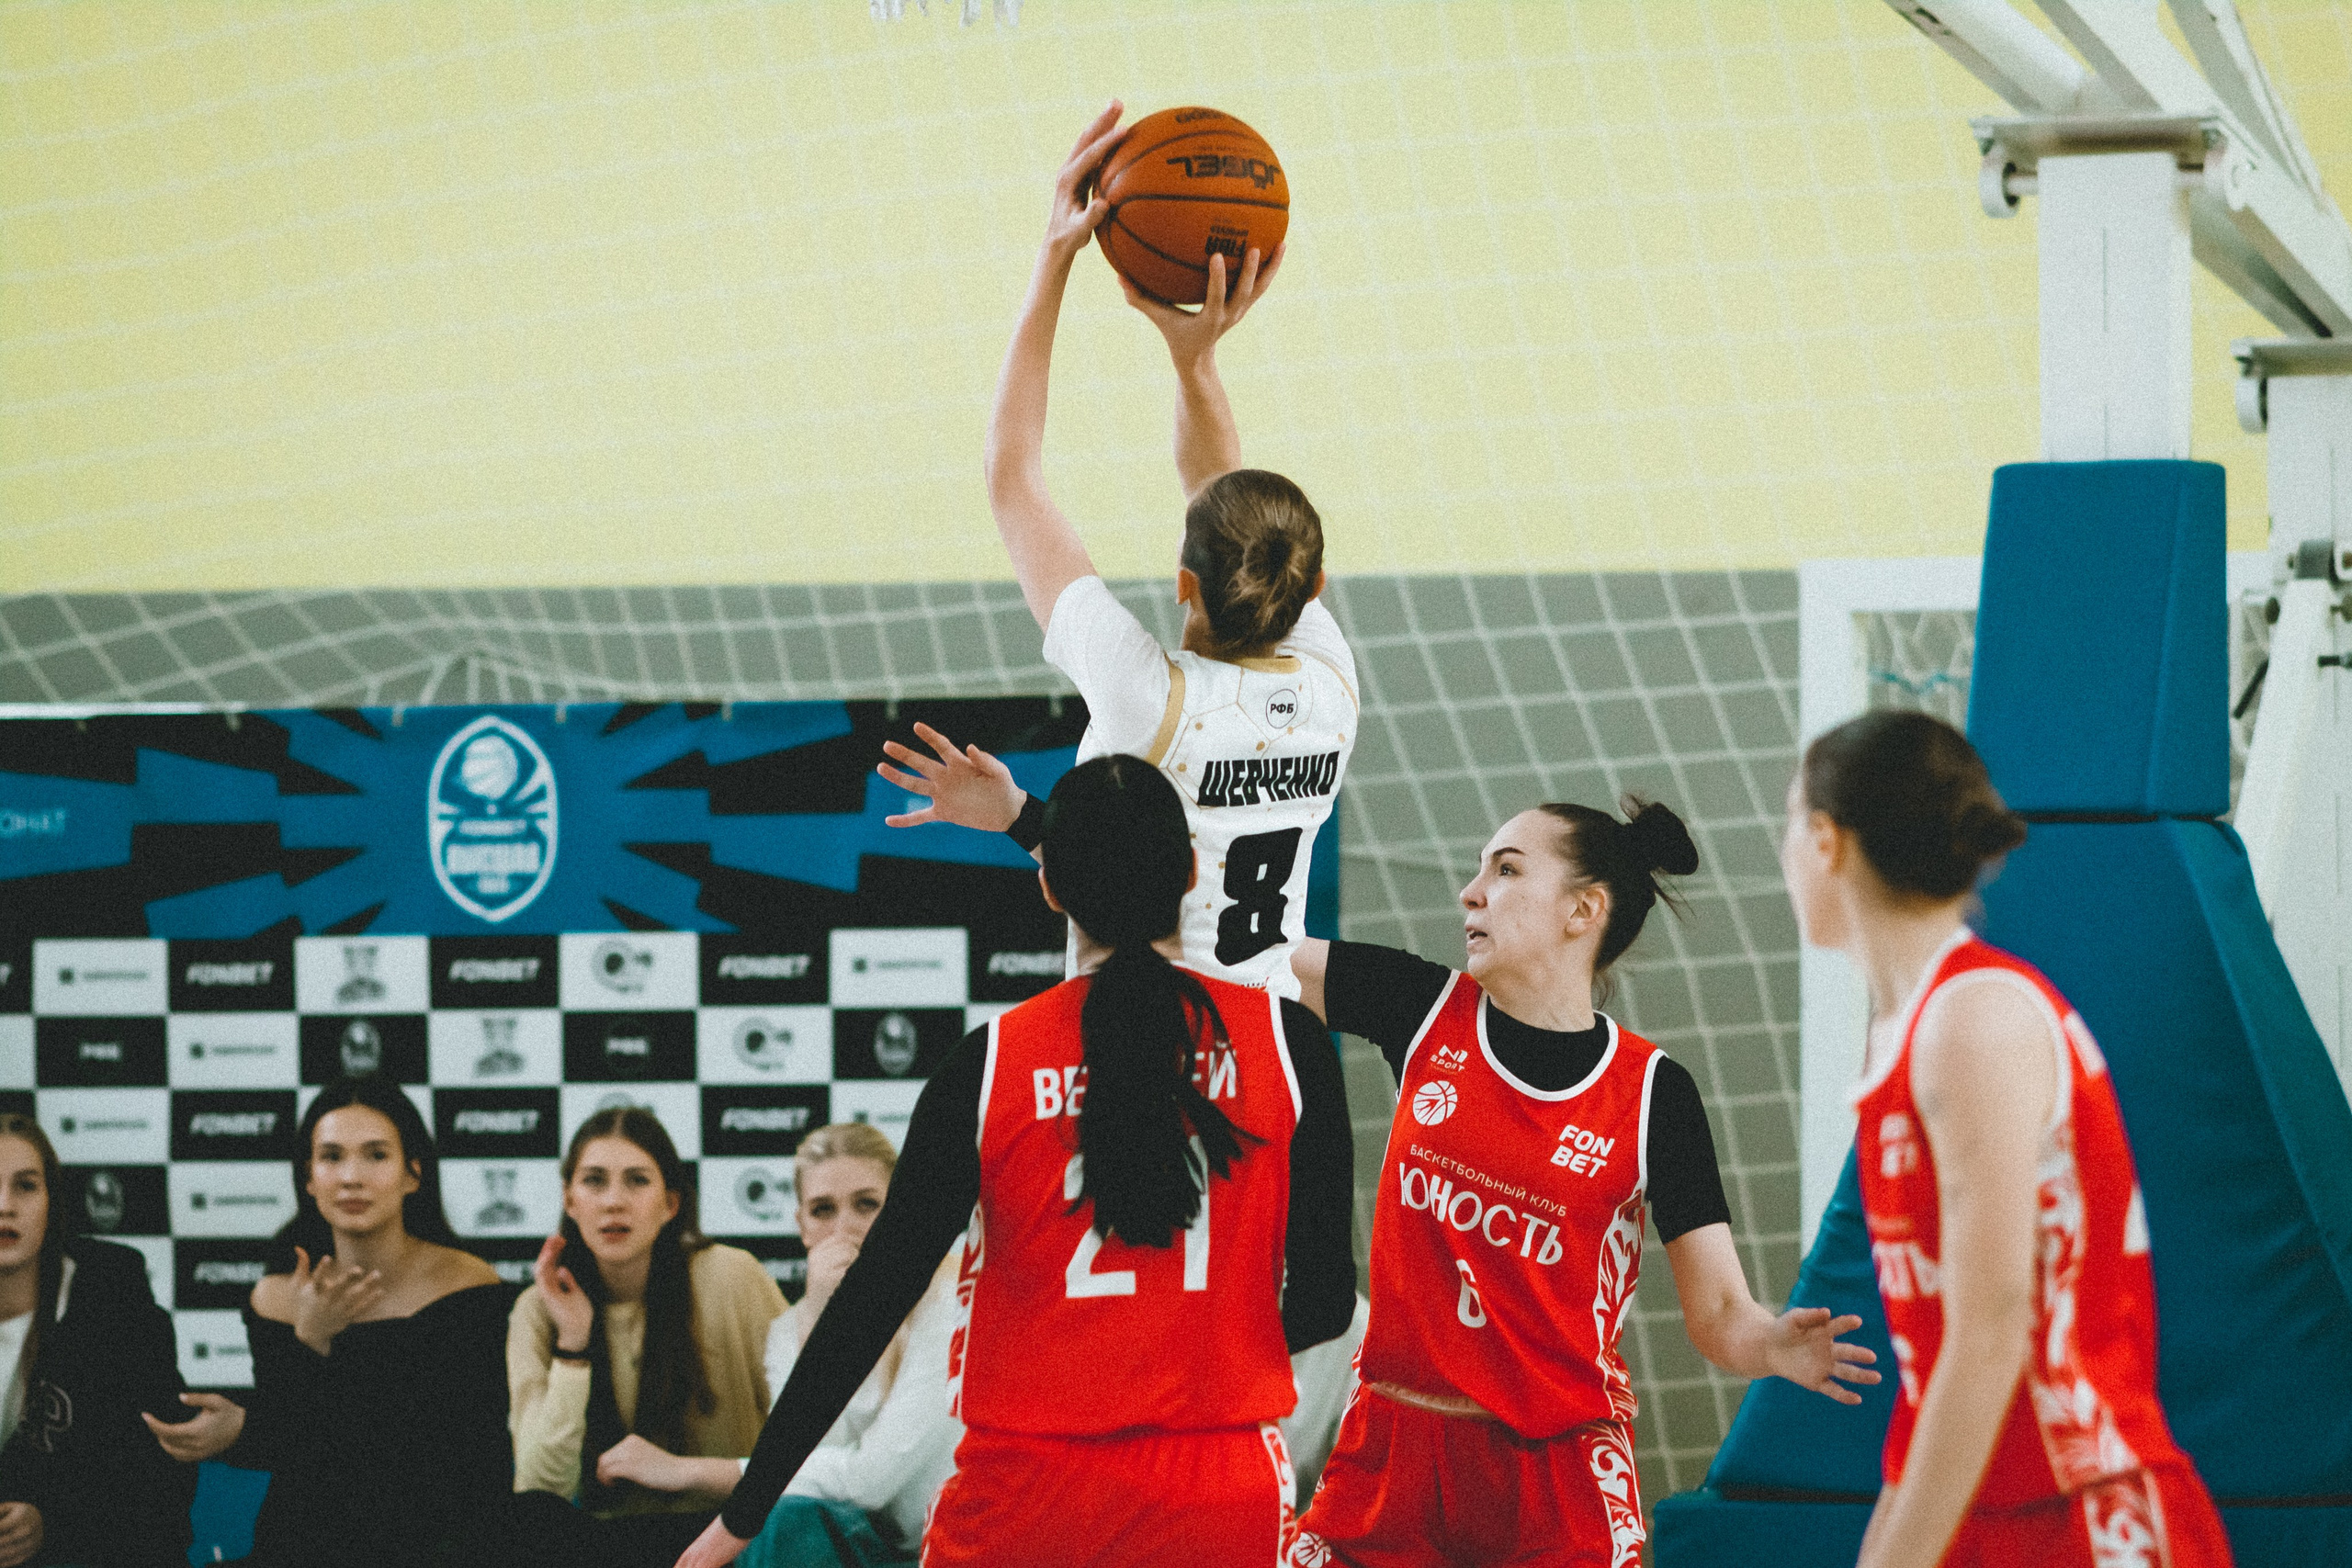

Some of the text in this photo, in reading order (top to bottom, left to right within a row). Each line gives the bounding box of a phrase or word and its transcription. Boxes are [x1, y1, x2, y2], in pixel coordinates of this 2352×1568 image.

[1270, 703, 1295, 714] РФБ
[1196, 750, 1340, 807] ШЕВЧЕНКО
[1215, 827, 1303, 966] 8
[1550, 1145, 1608, 1179] BET
[1558, 1124, 1615, 1157] FON
[1410, 1144, 1567, 1217] БАСКЕТБОЛЬНЫЙ КЛУБ
[1399, 1162, 1563, 1265] ЮНОСТЬ
